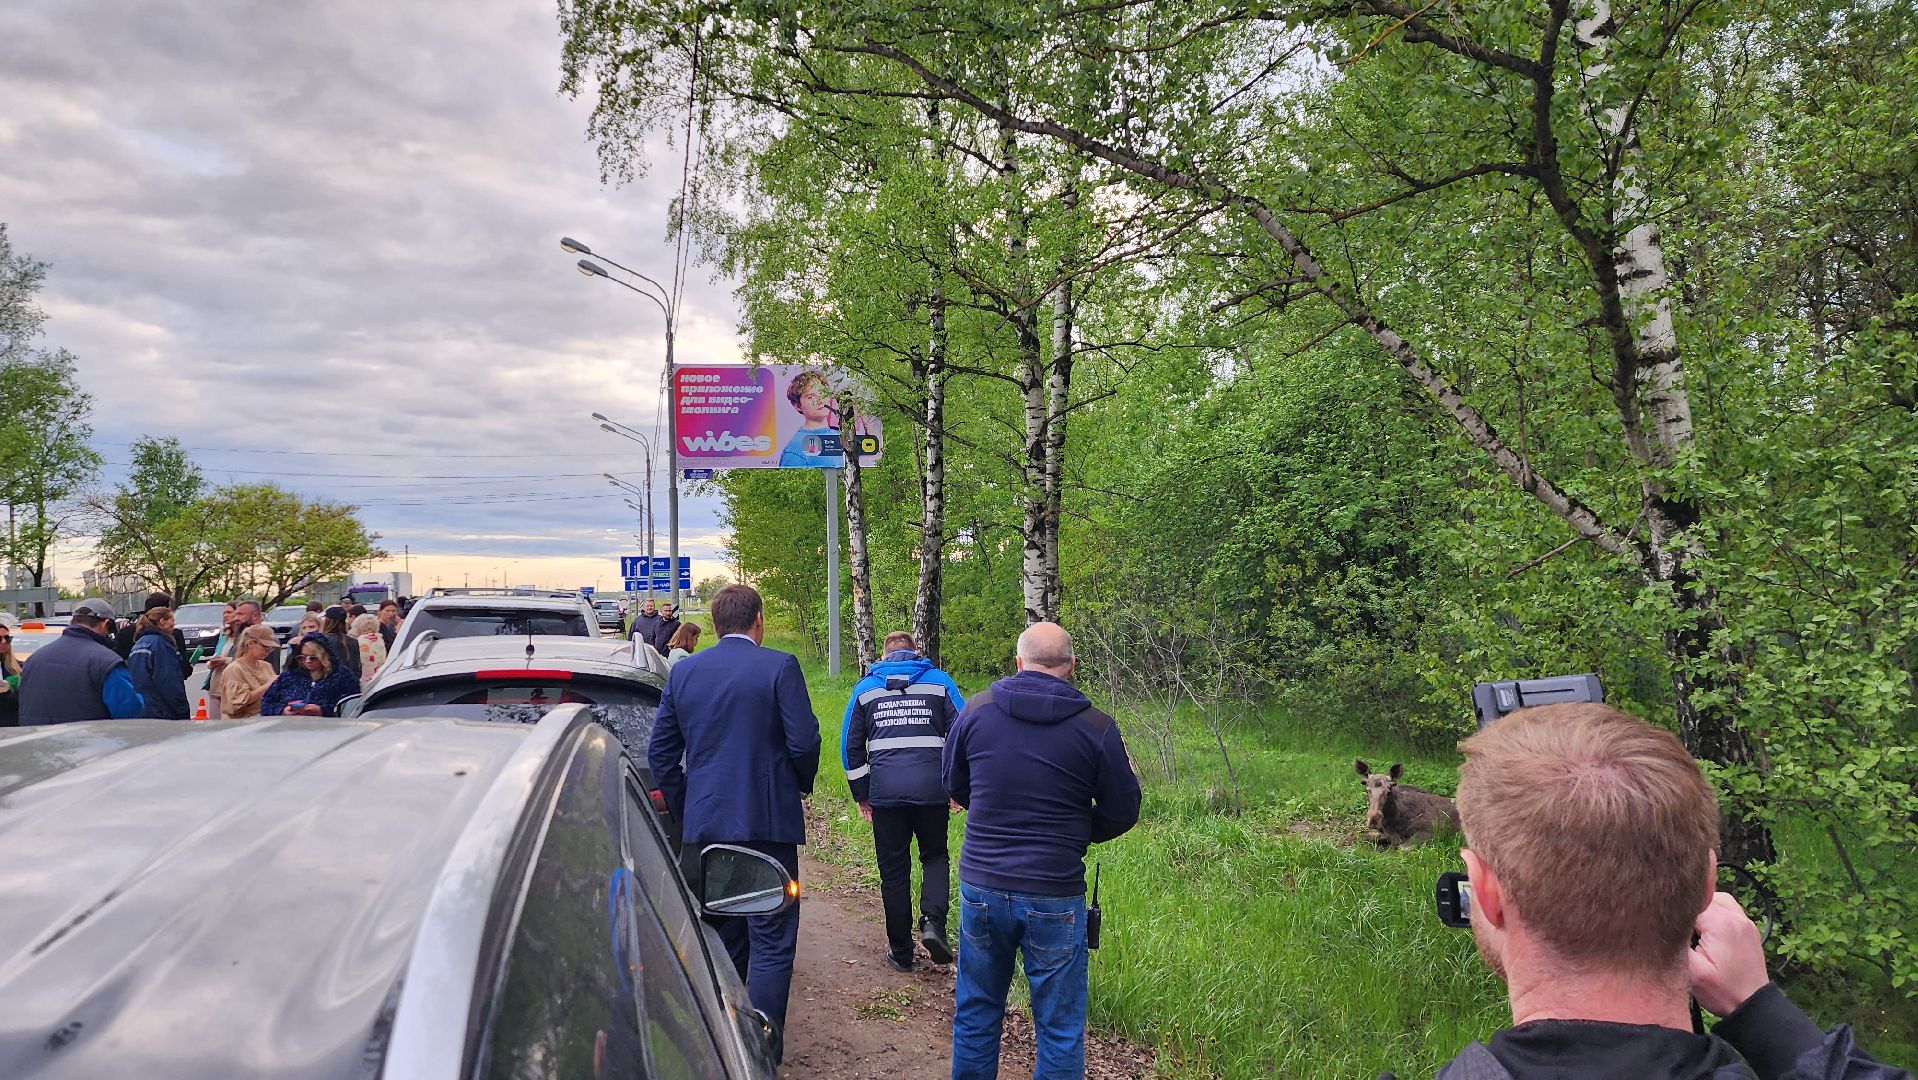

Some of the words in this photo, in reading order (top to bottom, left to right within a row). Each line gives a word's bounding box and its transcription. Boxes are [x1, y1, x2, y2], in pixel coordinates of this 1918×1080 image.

[680, 374, 720, 382] новое
[681, 386, 763, 395] приложение
[680, 396, 706, 405] для
[708, 397, 753, 405] видео-
